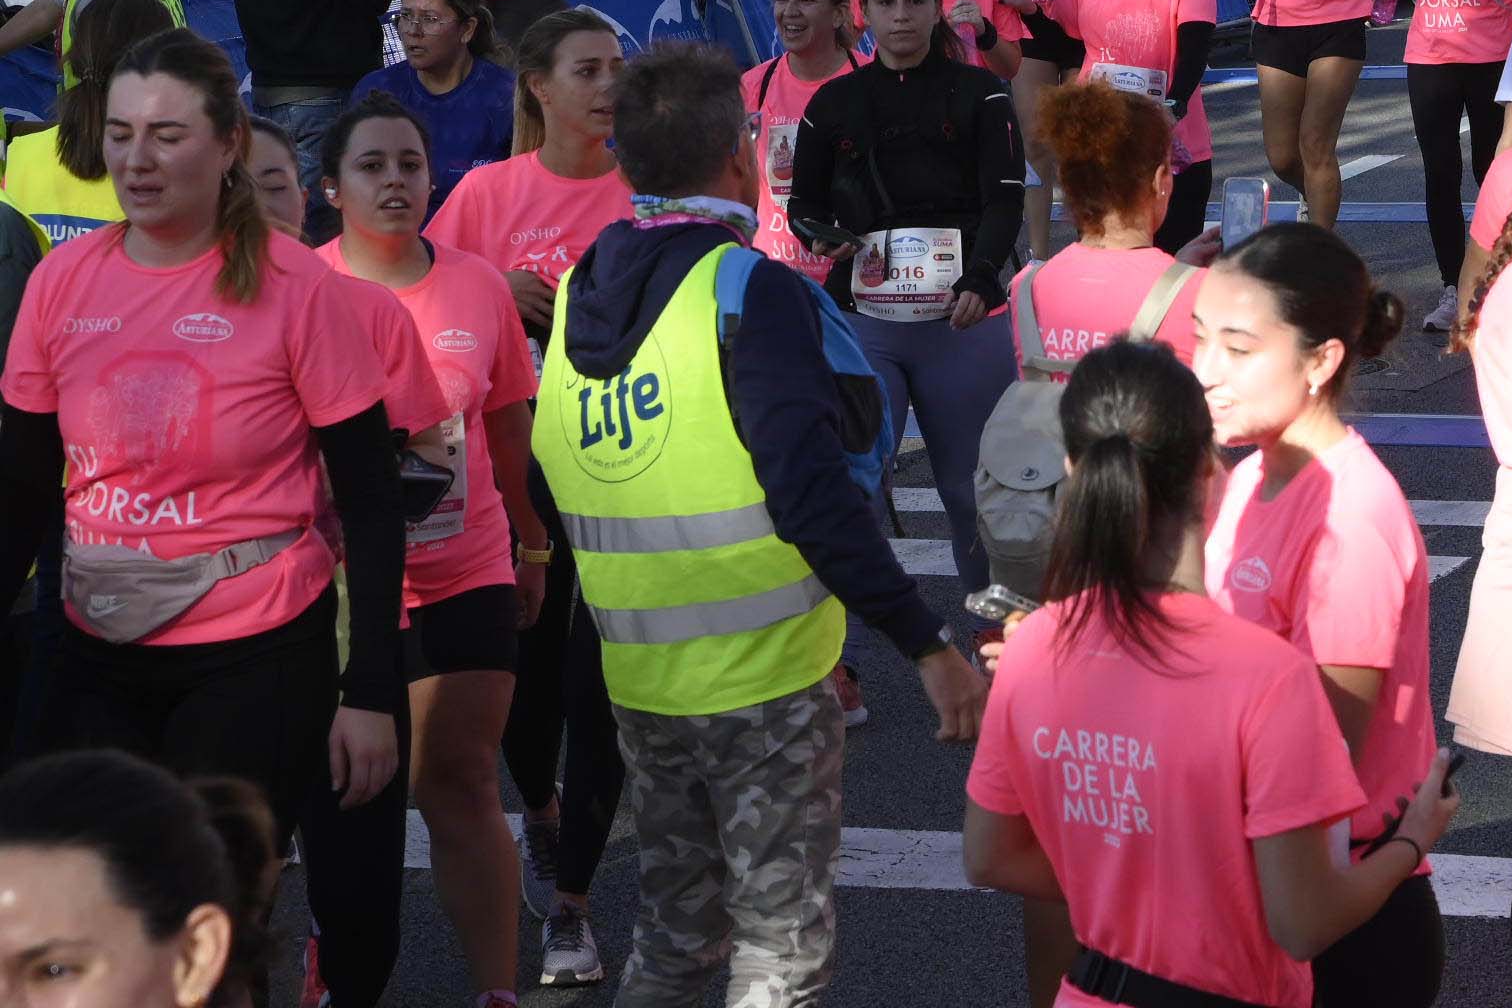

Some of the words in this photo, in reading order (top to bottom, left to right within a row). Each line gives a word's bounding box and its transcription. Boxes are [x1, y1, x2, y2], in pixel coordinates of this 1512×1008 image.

[511, 227, 561, 245] OYSHO
[889, 265, 925, 280] 016
[895, 284, 918, 293] 1171
[62, 315, 122, 335] OYSHO
[177, 319, 229, 338] ASTURIANA
[578, 363, 665, 450] Life
[1032, 726, 1157, 772] CARRERA
[1062, 760, 1100, 794] DE
[1109, 768, 1141, 802] LA
[1063, 795, 1154, 835] MUJER
